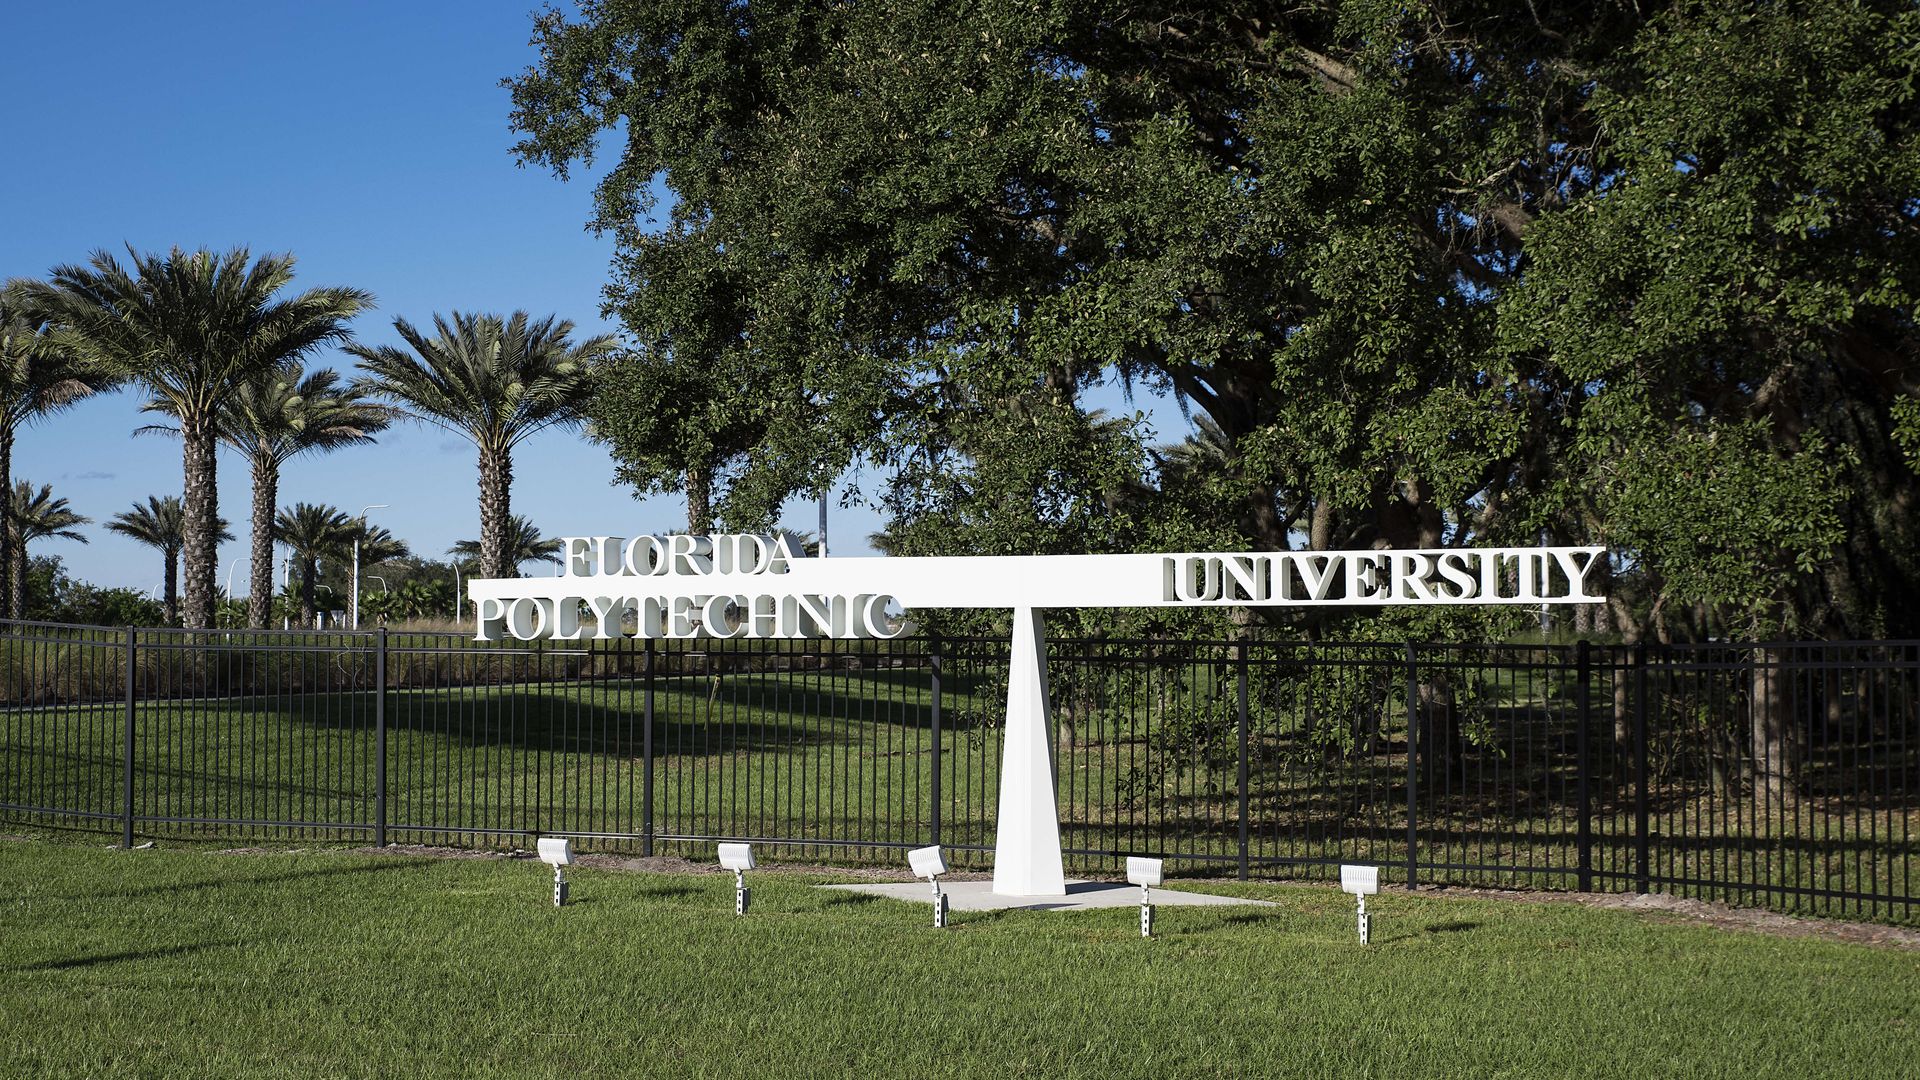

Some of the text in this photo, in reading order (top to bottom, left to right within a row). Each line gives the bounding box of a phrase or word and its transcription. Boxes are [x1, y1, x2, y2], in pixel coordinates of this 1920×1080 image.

[563, 533, 800, 577] FLORIDA
[1168, 548, 1606, 602] UNIVERSITY
[472, 595, 911, 640] POLYTECHNIC
